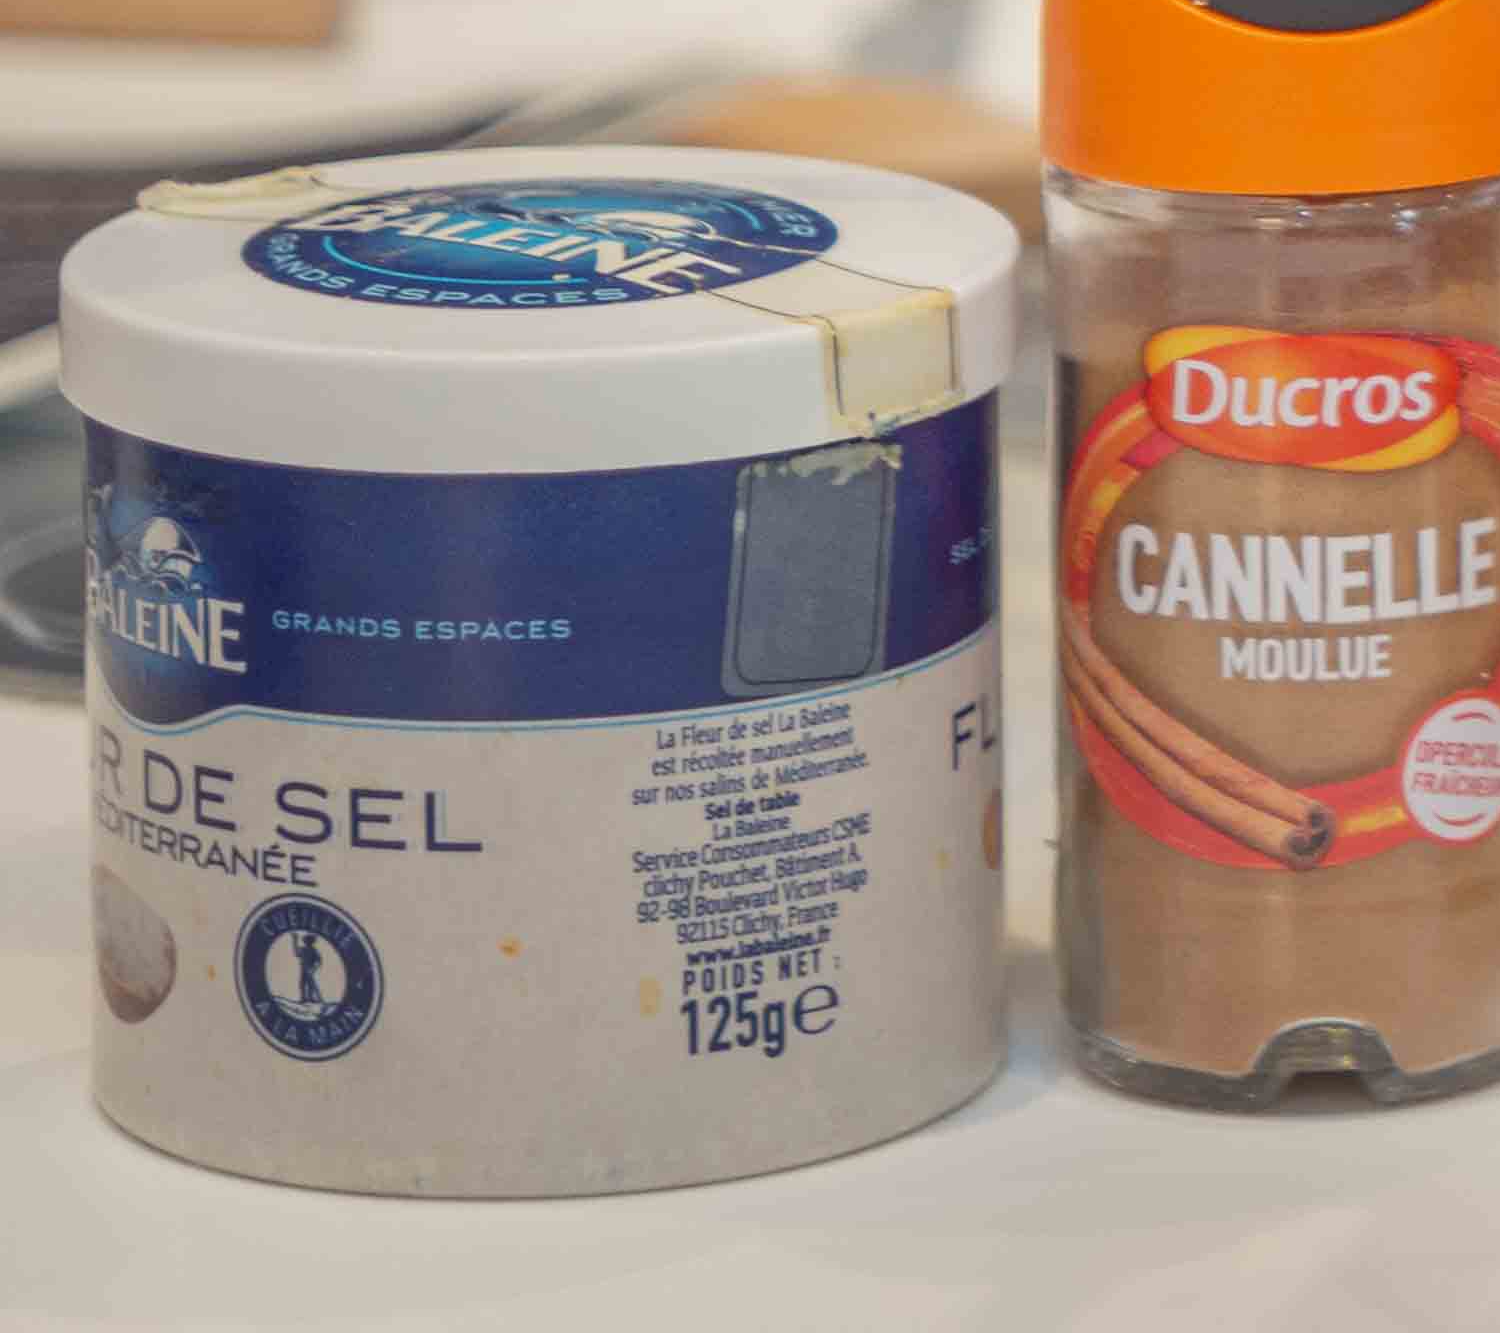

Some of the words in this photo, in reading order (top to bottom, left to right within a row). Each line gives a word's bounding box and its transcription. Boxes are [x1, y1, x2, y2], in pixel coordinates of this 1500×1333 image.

[267, 233, 353, 289] GRANDS
[361, 284, 630, 305] ESPACES
[286, 204, 742, 295] BALEINE
[1172, 359, 1440, 429] Ducros
[1117, 517, 1497, 625] CANNELLE
[272, 610, 401, 639] GRANDS
[415, 618, 573, 641] ESPACES
[1220, 634, 1392, 682] MOULUE
[657, 729, 676, 750] La
[681, 724, 723, 747] Fleur
[728, 717, 747, 740] de
[752, 714, 774, 737] sel
[778, 713, 795, 733] La
[800, 702, 851, 728] Baleine
[651, 758, 676, 776] est
[751, 726, 854, 763] manuellement
[143, 748, 236, 833] DE
[275, 781, 483, 854] SEL
[632, 788, 659, 805] sur
[665, 784, 695, 802] nos
[699, 774, 745, 798] salins
[752, 770, 769, 789] de
[705, 800, 731, 820] Sel
[735, 797, 755, 815] de
[760, 791, 801, 812] table
[632, 847, 698, 873] Service
[701, 828, 830, 866] Consommateurs
[713, 823, 731, 841] La
[736, 815, 790, 837] Baleine
[695, 887, 778, 917] Boulevard
[782, 878, 828, 902] Victor
[831, 869, 868, 892] Hugo
[787, 901, 839, 927] France
[683, 960, 764, 995] POIDS
[778, 947, 822, 981] NET
[680, 990, 785, 1058] 125g
